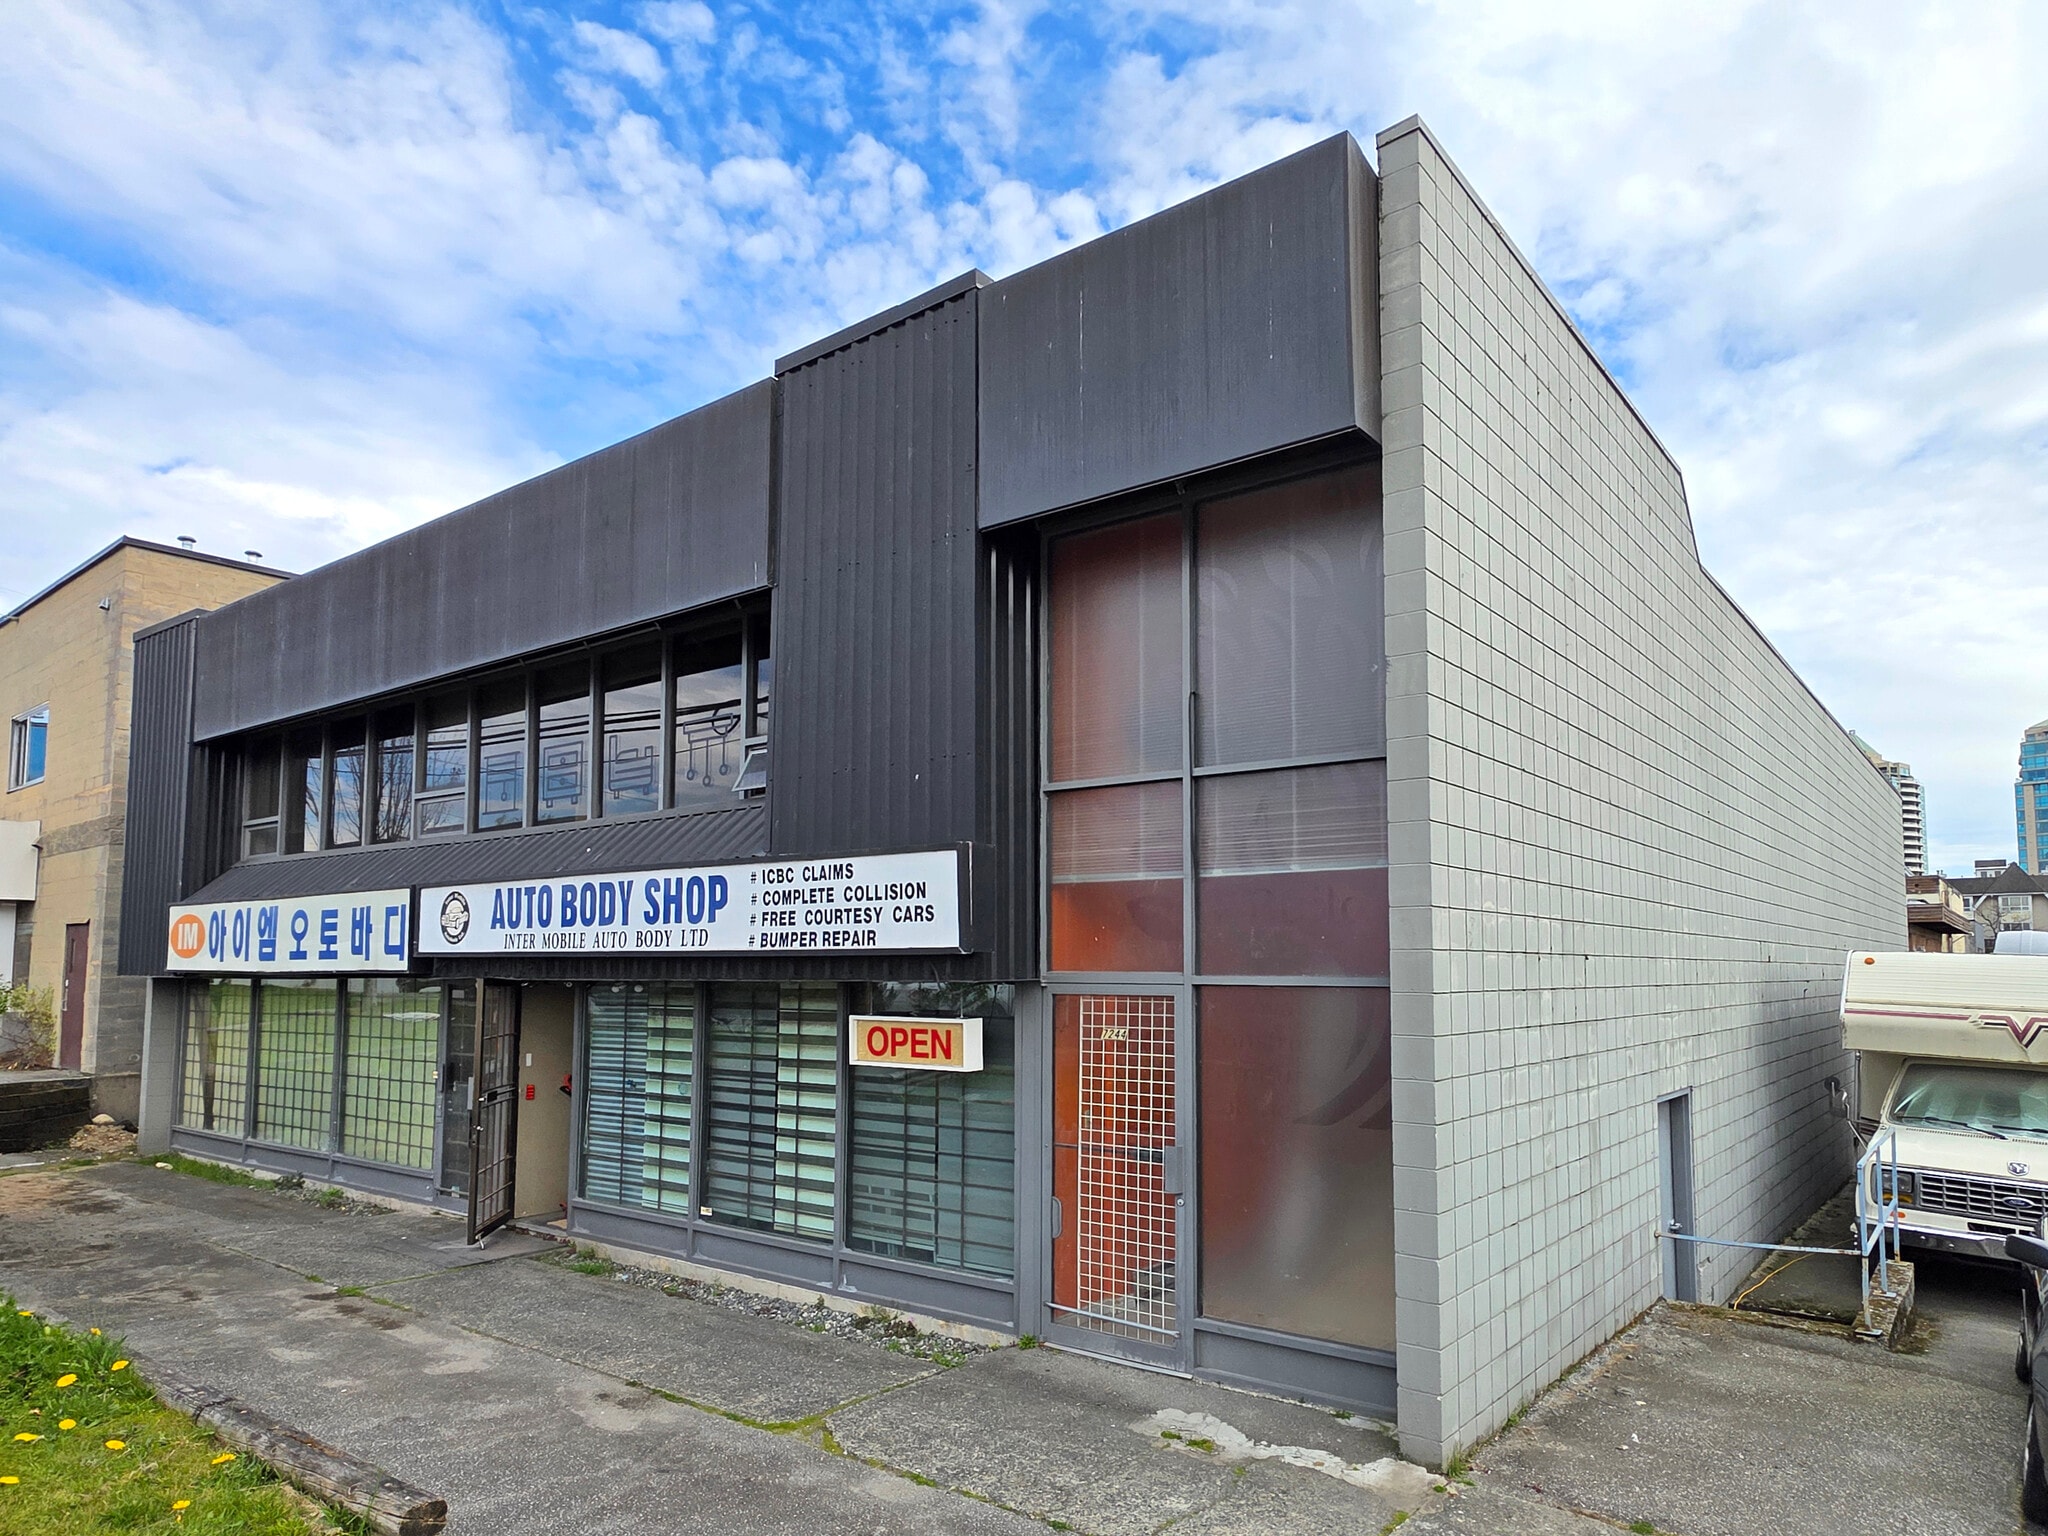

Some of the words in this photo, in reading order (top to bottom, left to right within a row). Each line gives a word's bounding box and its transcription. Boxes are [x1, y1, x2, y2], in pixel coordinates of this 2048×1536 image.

[762, 867, 794, 884] ICBC
[802, 863, 854, 882] CLAIMS
[490, 885, 552, 929] AUTO
[561, 880, 634, 928] BODY
[643, 875, 728, 925] SHOP
[762, 887, 834, 906] COMPLETE
[843, 882, 926, 902] COLLISION
[761, 911, 796, 926] FREE
[804, 907, 883, 925] COURTESY
[892, 905, 934, 923] CARS
[177, 923, 198, 949] IM
[208, 905, 279, 962] 아이엠
[289, 904, 406, 961] 오토바디
[504, 933, 536, 949] INTER
[542, 932, 586, 949] MOBILE
[592, 931, 627, 948] AUTO
[636, 930, 672, 948] BODY
[681, 929, 709, 947] LTD
[760, 932, 818, 948] BUMPER
[822, 930, 876, 947] REPAIR
[867, 1026, 952, 1060] OPEN
